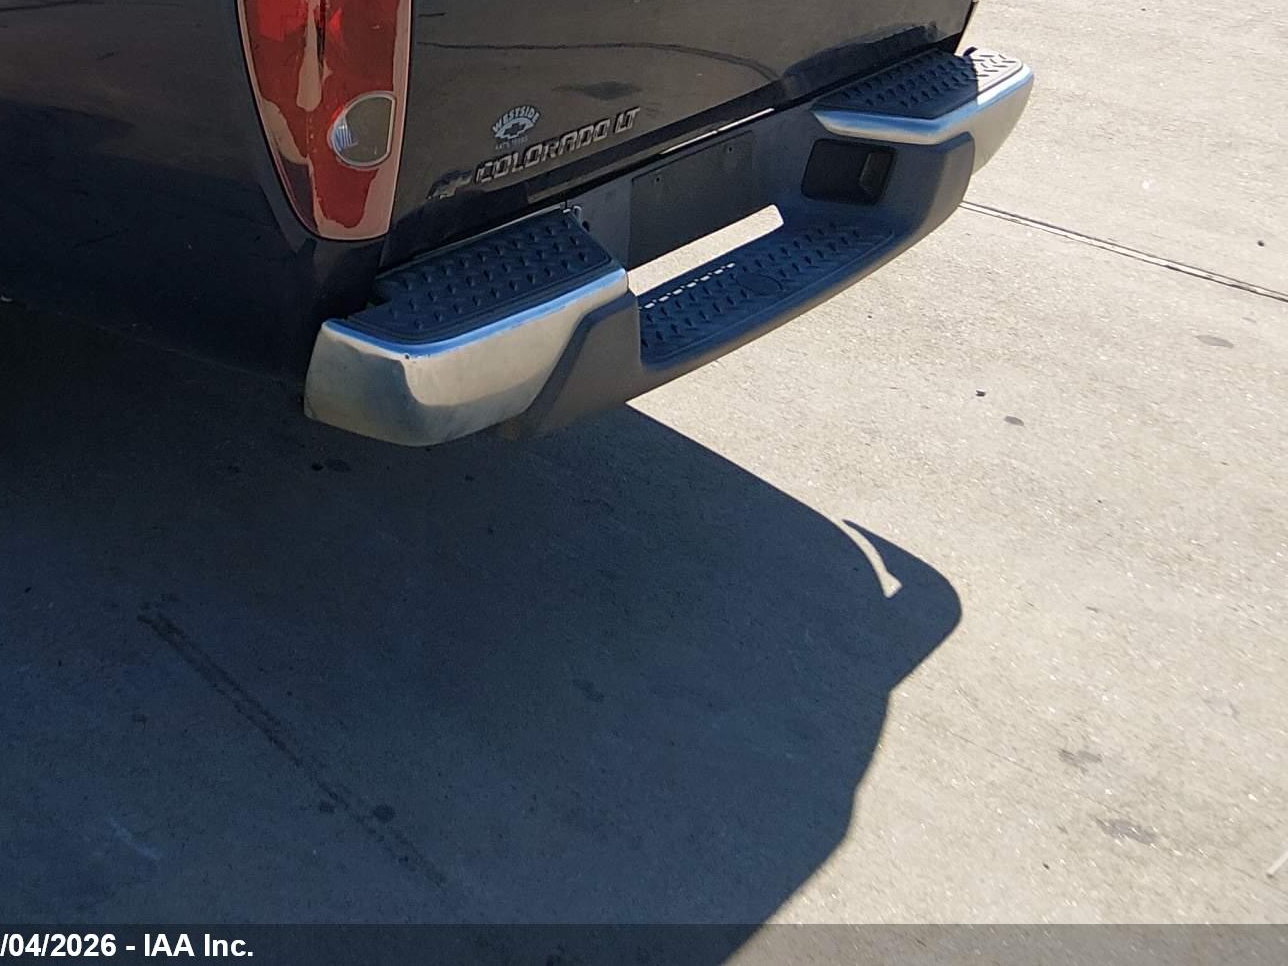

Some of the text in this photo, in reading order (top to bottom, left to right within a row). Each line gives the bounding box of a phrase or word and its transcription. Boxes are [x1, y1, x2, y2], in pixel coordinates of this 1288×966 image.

[492, 105, 541, 132] WESTSIDE
[474, 106, 641, 185] COLORADO LT
